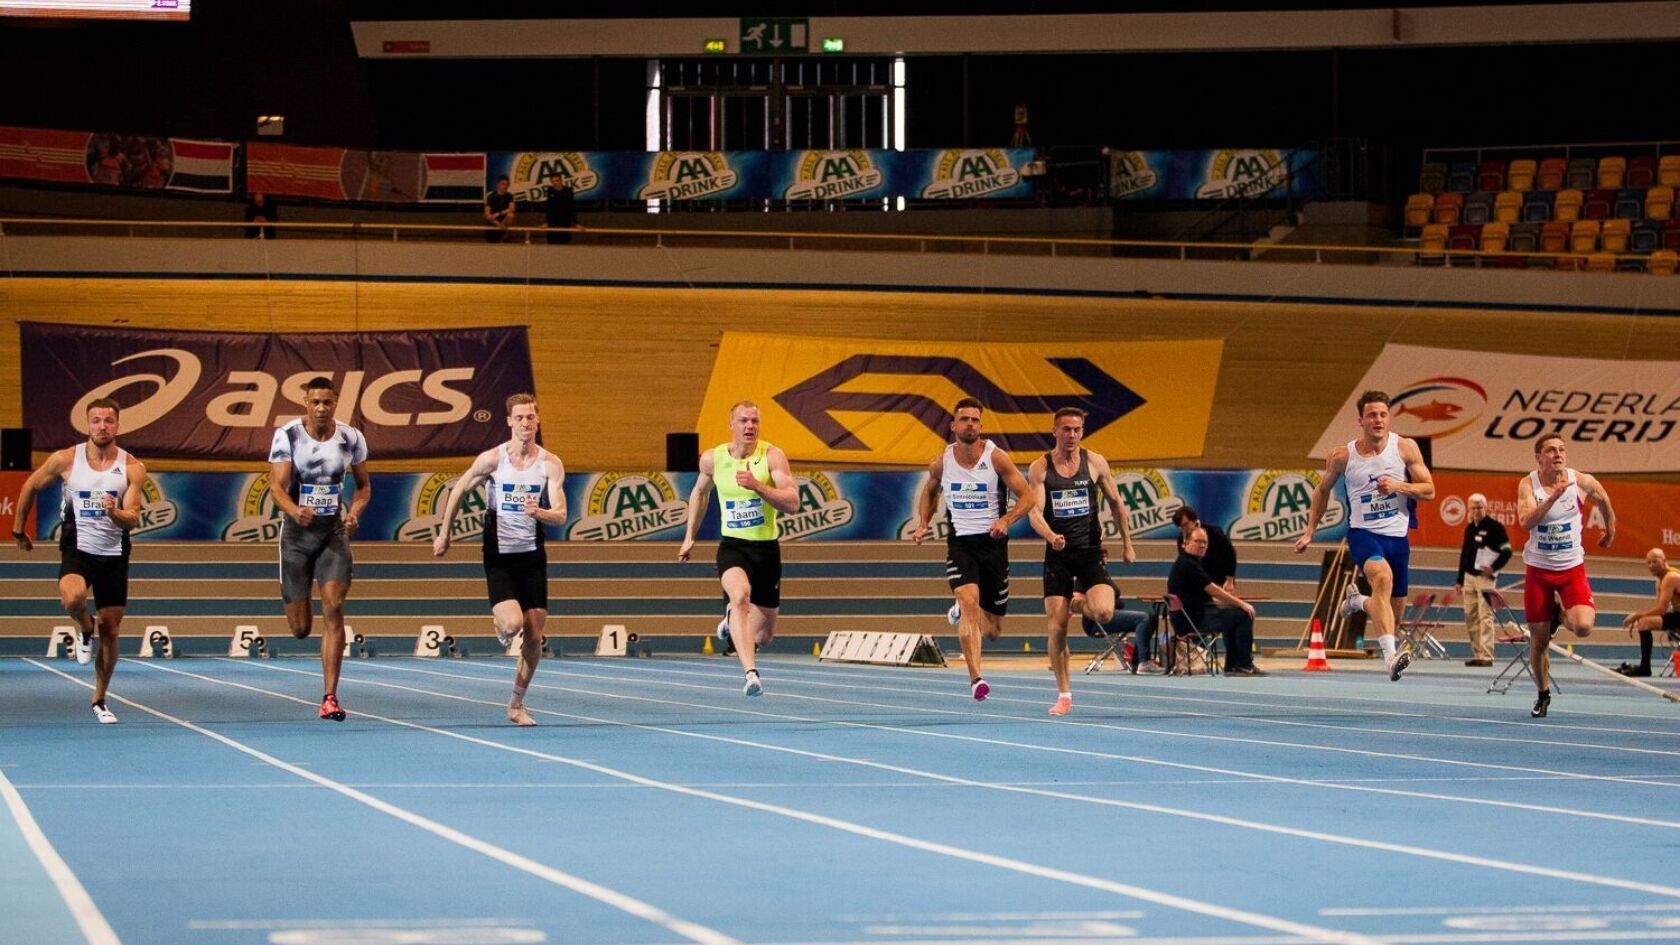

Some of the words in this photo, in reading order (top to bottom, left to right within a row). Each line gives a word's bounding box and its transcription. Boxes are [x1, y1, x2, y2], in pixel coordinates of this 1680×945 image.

[675, 158, 712, 183] AA
[820, 157, 858, 183] AA
[960, 156, 994, 181] AA
[1117, 157, 1131, 178] A
[1232, 157, 1263, 180] AA
[669, 177, 720, 199] DRINK
[814, 177, 865, 198] DRINK
[951, 175, 1002, 198] DRINK
[205, 367, 475, 428] asics
[1484, 416, 1676, 442] LOTERIJ
[306, 496, 333, 506] Raap
[613, 484, 660, 518] AA
[1054, 499, 1088, 508] Hulleman
[1116, 481, 1156, 511] AA
[1272, 483, 1312, 517] AA
[1370, 501, 1392, 512] Mak
[605, 509, 669, 540] DRINK
[730, 510, 759, 520] Taam
[1103, 507, 1165, 537] DINK
[240, 630, 255, 650] 5
[426, 630, 441, 650] 3
[608, 630, 618, 650] 1
